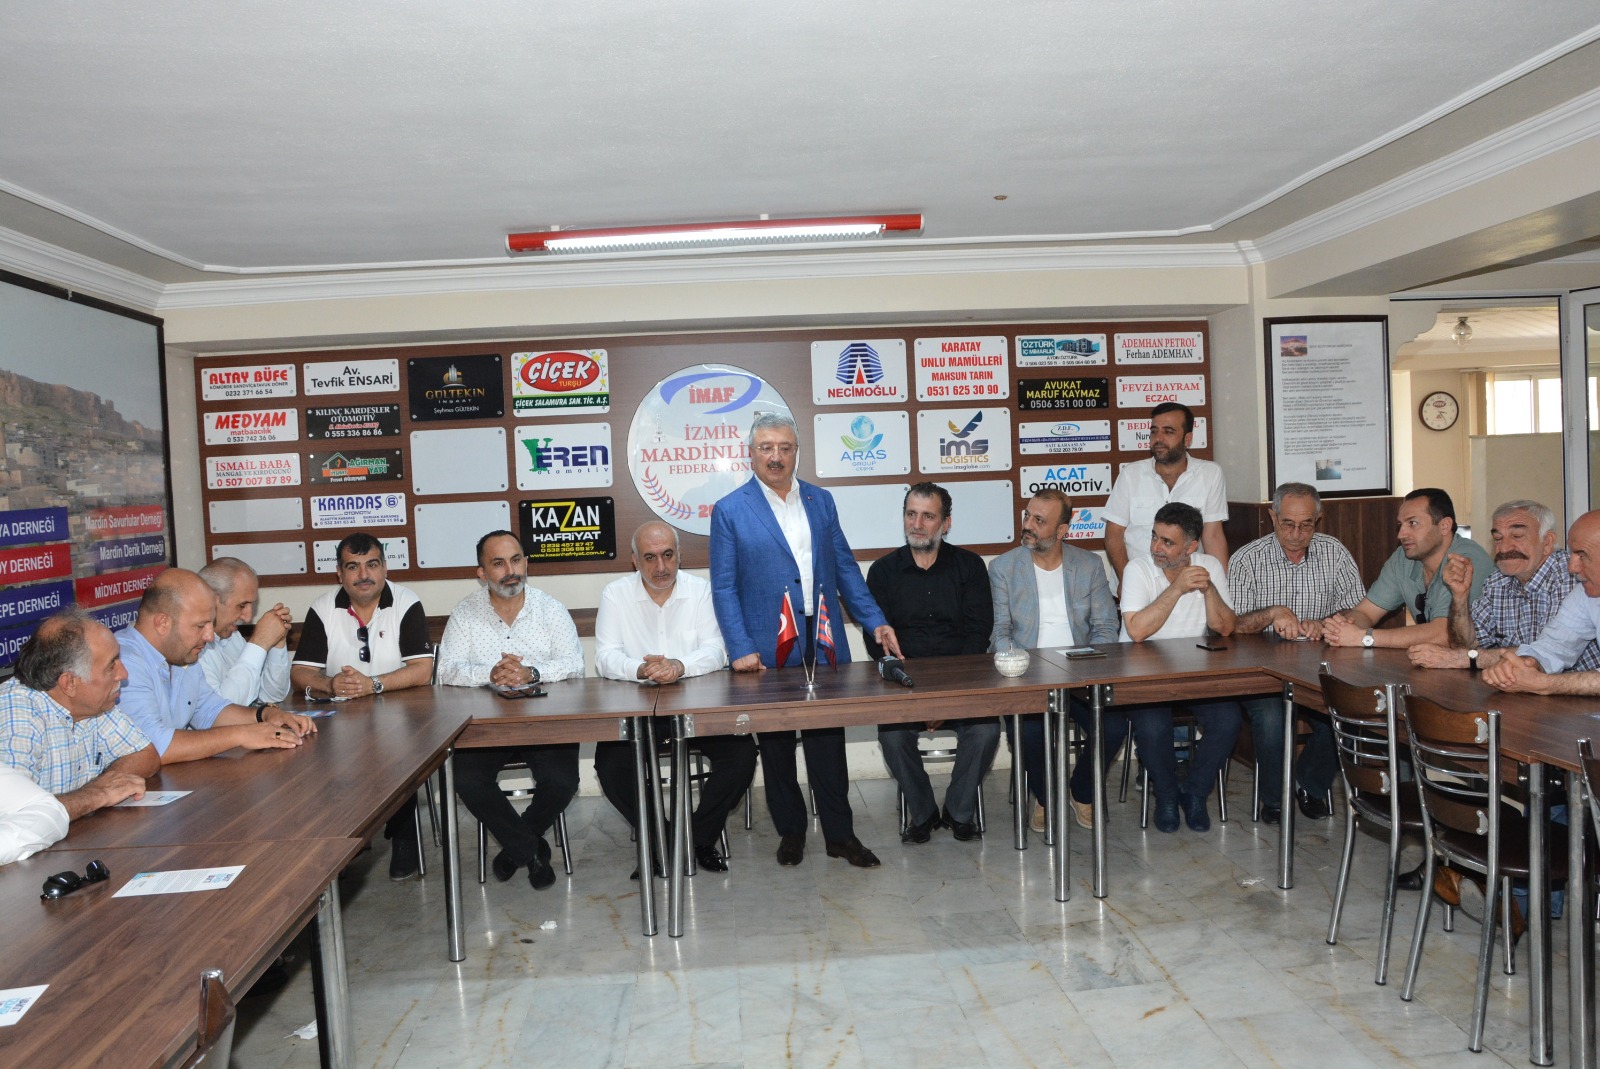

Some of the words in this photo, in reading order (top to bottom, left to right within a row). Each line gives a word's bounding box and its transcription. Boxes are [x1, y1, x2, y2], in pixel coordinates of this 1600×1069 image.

[942, 342, 981, 352] KARATAY
[1122, 339, 1163, 348] ADEMHAN
[1165, 338, 1196, 348] PETROL
[1126, 349, 1150, 358] Ferhan
[1152, 349, 1193, 358] ADEMHAN
[921, 357, 945, 368] UNLU
[948, 354, 1002, 367] MAMÜLLERİ
[209, 372, 249, 384] ALTAY
[254, 367, 287, 382] BÜFE
[343, 365, 360, 376] Av.
[528, 358, 592, 383] ÇİÇEK
[932, 372, 967, 381] MAHSUN
[970, 371, 993, 380] TARIN
[311, 377, 344, 388] Tevfik
[350, 373, 393, 386] ENSARİ
[1045, 381, 1082, 389] AVUKAT
[1122, 381, 1153, 392] FEVZİ
[1156, 382, 1200, 391] BAYRAM
[689, 385, 734, 404] İMAF
[828, 385, 896, 398] NECİMOĞLU
[927, 385, 949, 397] 0531
[953, 385, 970, 396] 625
[973, 384, 985, 395] 30
[987, 384, 998, 394] 90
[1027, 390, 1060, 399] MARUF
[1062, 389, 1100, 398] KAYMAZ
[515, 399, 533, 407] ÇİÇEK
[535, 398, 567, 406] SALAMURA
[583, 396, 594, 404] TİC.
[596, 396, 608, 405] A.Ş.
[1031, 400, 1052, 408] 0506
[1055, 399, 1070, 408] 351
[1073, 399, 1083, 408] 00
[1086, 399, 1096, 407] 00
[1145, 394, 1178, 403] ECZACI
[316, 408, 342, 418] KILINÇ
[344, 406, 390, 416] KARDEŞLER
[330, 414, 376, 422] OTOMOTİV
[215, 412, 286, 429] MEDYAM
[230, 427, 271, 436] matbaacılık
[685, 423, 740, 441] İZMİR
[940, 438, 988, 456] ims
[350, 457, 387, 466] AĞIRMAN
[840, 450, 886, 462] ARAS
[940, 455, 989, 464] LOGISTICS
[215, 460, 257, 471] İSMAİL
[260, 460, 291, 469] BABA
[1045, 467, 1087, 480] ACAT
[226, 478, 242, 486] 507
[246, 477, 262, 485] 007
[280, 476, 292, 484] 89
[1029, 478, 1103, 493] OTOMOTİV
[318, 496, 382, 511] KARADAŞ
[388, 497, 396, 506] 6
[85, 516, 107, 530] Mardin
[109, 514, 139, 528] Savurlular
[140, 512, 163, 528] Derneği
[531, 501, 600, 532] KAZAN
[12, 516, 55, 536] DERNEĞİ
[100, 546, 123, 560] Mardin
[124, 542, 140, 557] Derik
[141, 540, 164, 556] Derneği
[10, 552, 53, 573] DERNEĞİ
[95, 583, 121, 599] MİDYAT
[18, 591, 60, 614] DERNEĞİ
